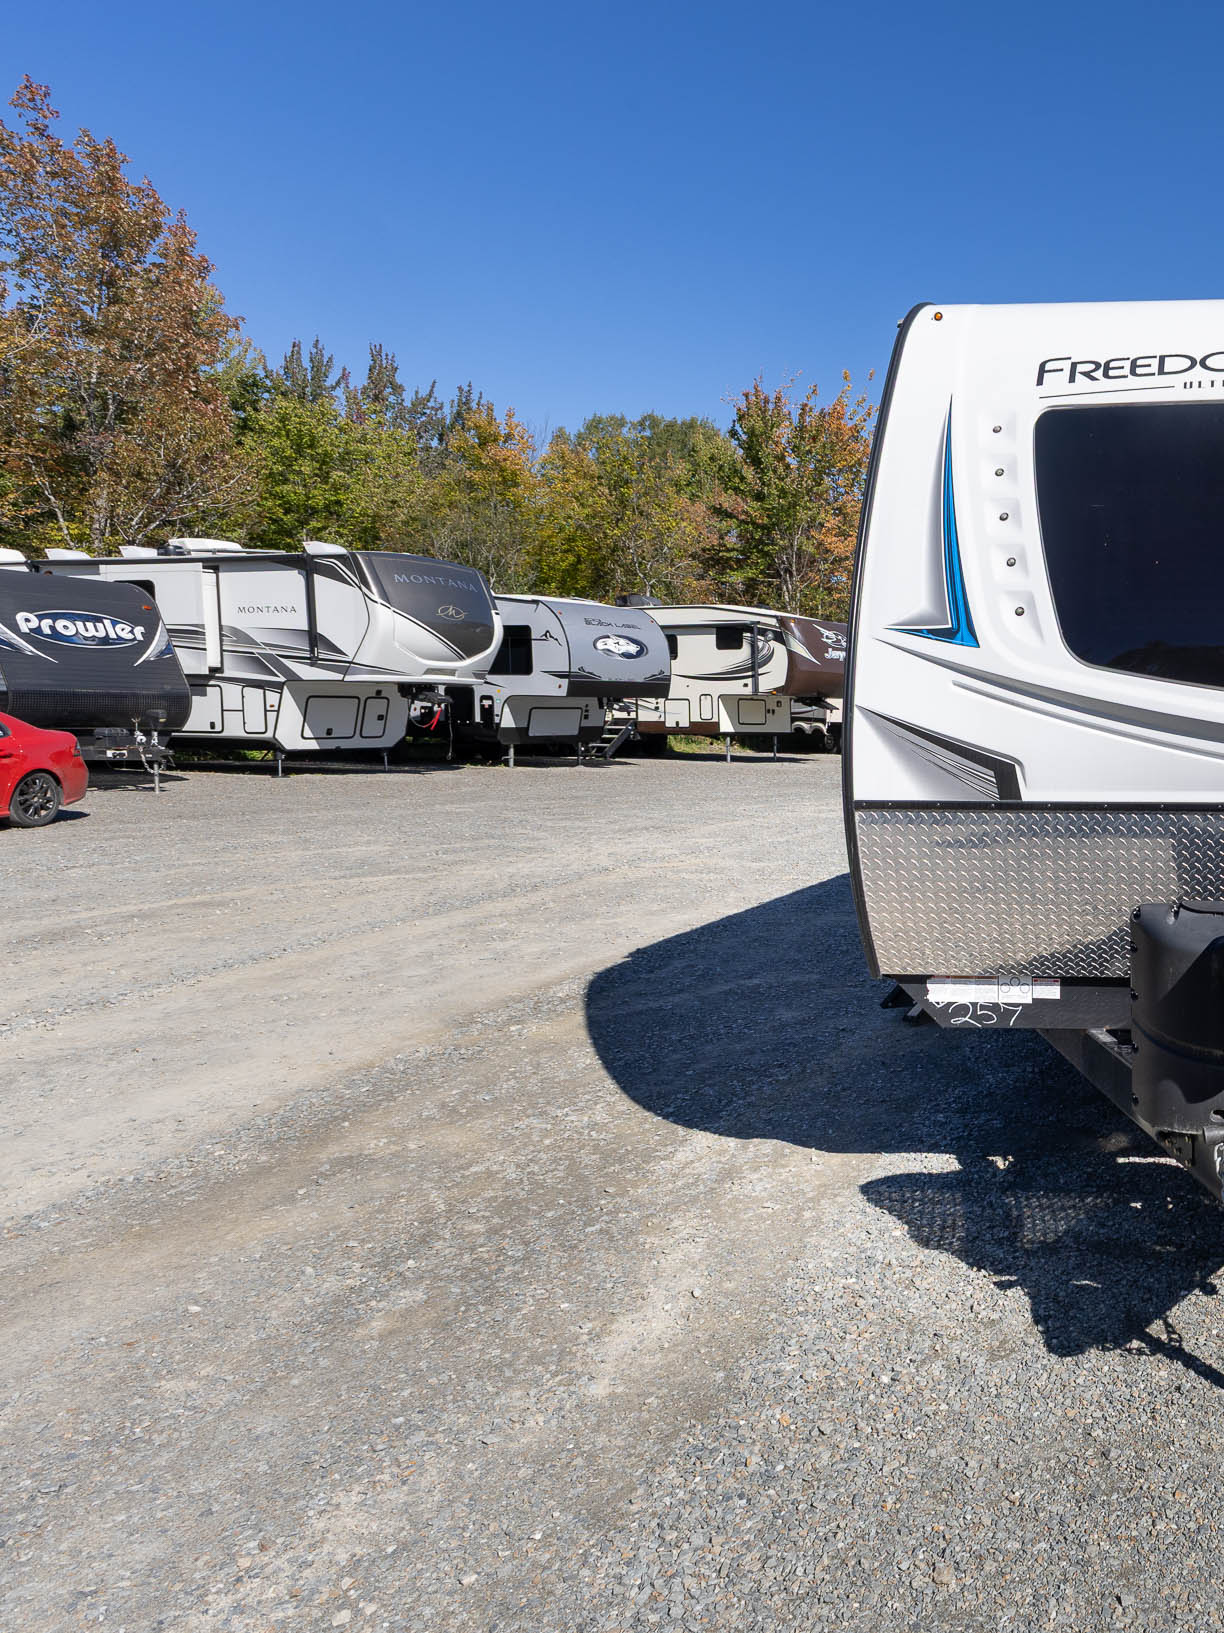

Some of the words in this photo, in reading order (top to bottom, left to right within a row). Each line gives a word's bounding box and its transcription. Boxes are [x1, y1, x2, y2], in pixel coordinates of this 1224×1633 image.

[393, 573, 479, 593] MONTANA
[236, 605, 297, 614] MONTANA
[15, 611, 146, 641] Prowler
[948, 1001, 1023, 1028] 257
